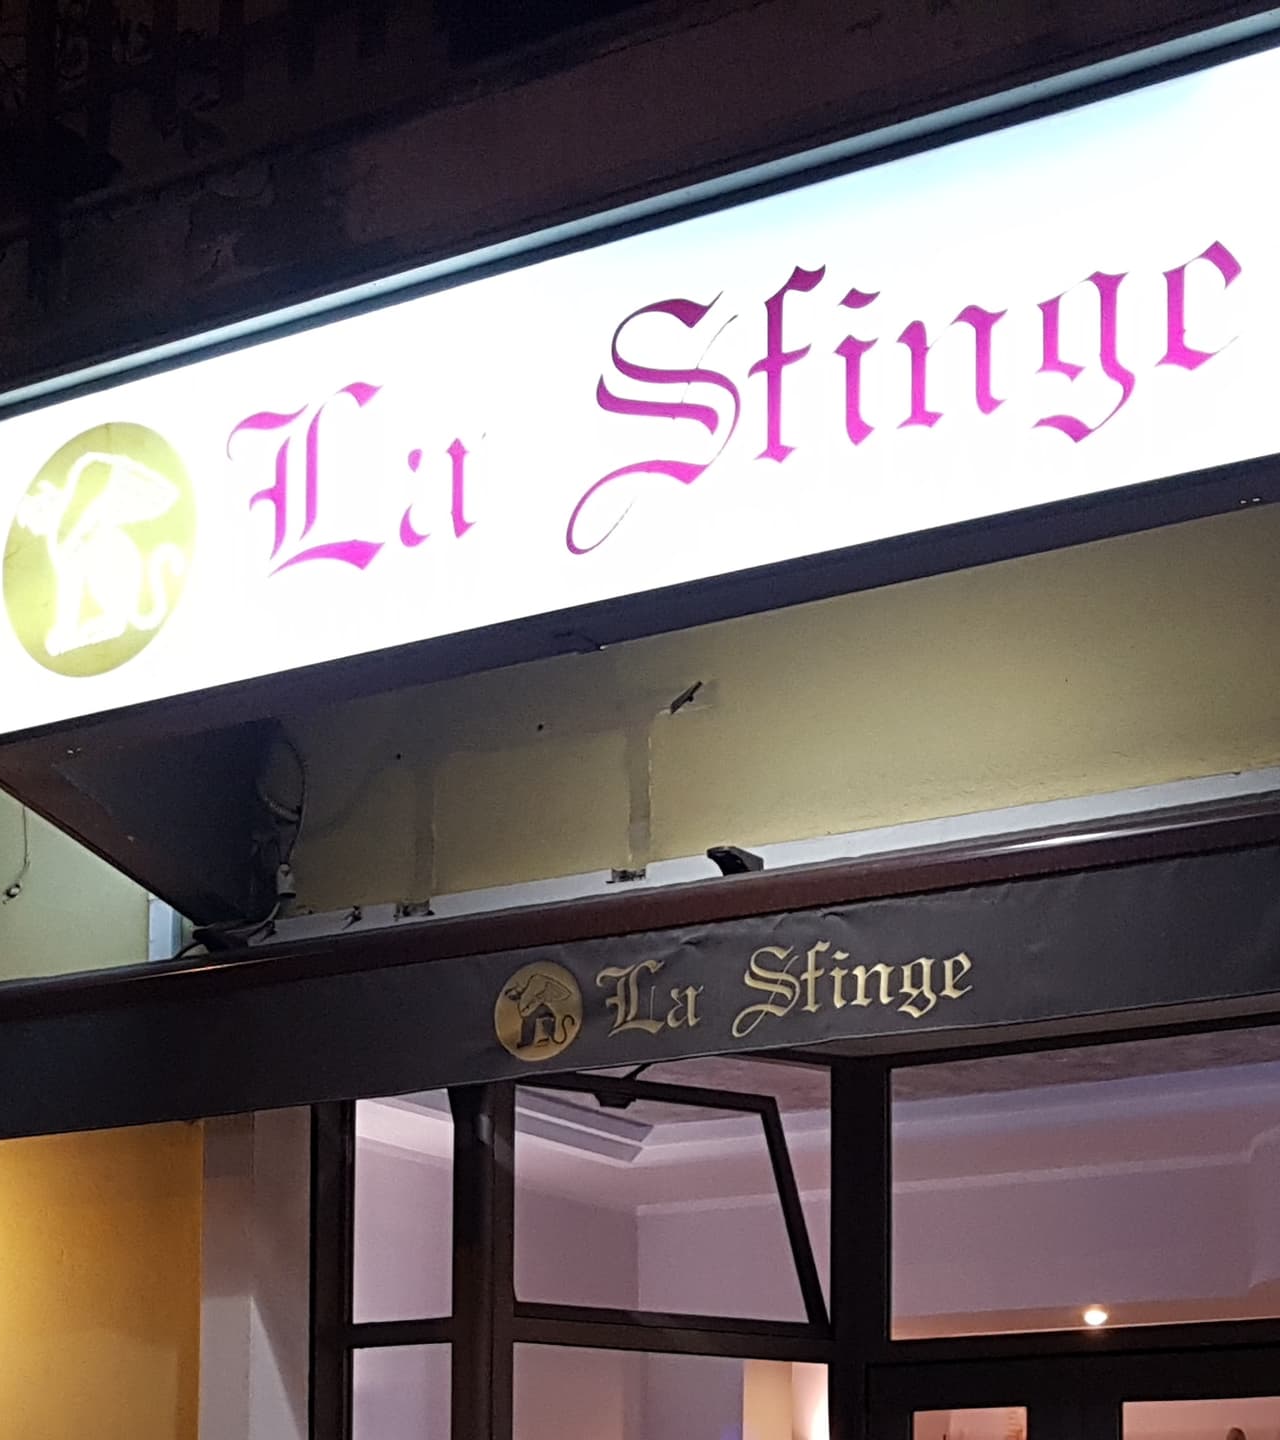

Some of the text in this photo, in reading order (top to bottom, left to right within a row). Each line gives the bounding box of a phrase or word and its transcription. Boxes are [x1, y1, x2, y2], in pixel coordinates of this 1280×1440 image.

[226, 239, 1243, 576] La Sfinge
[595, 939, 973, 1039] La Sfinge
